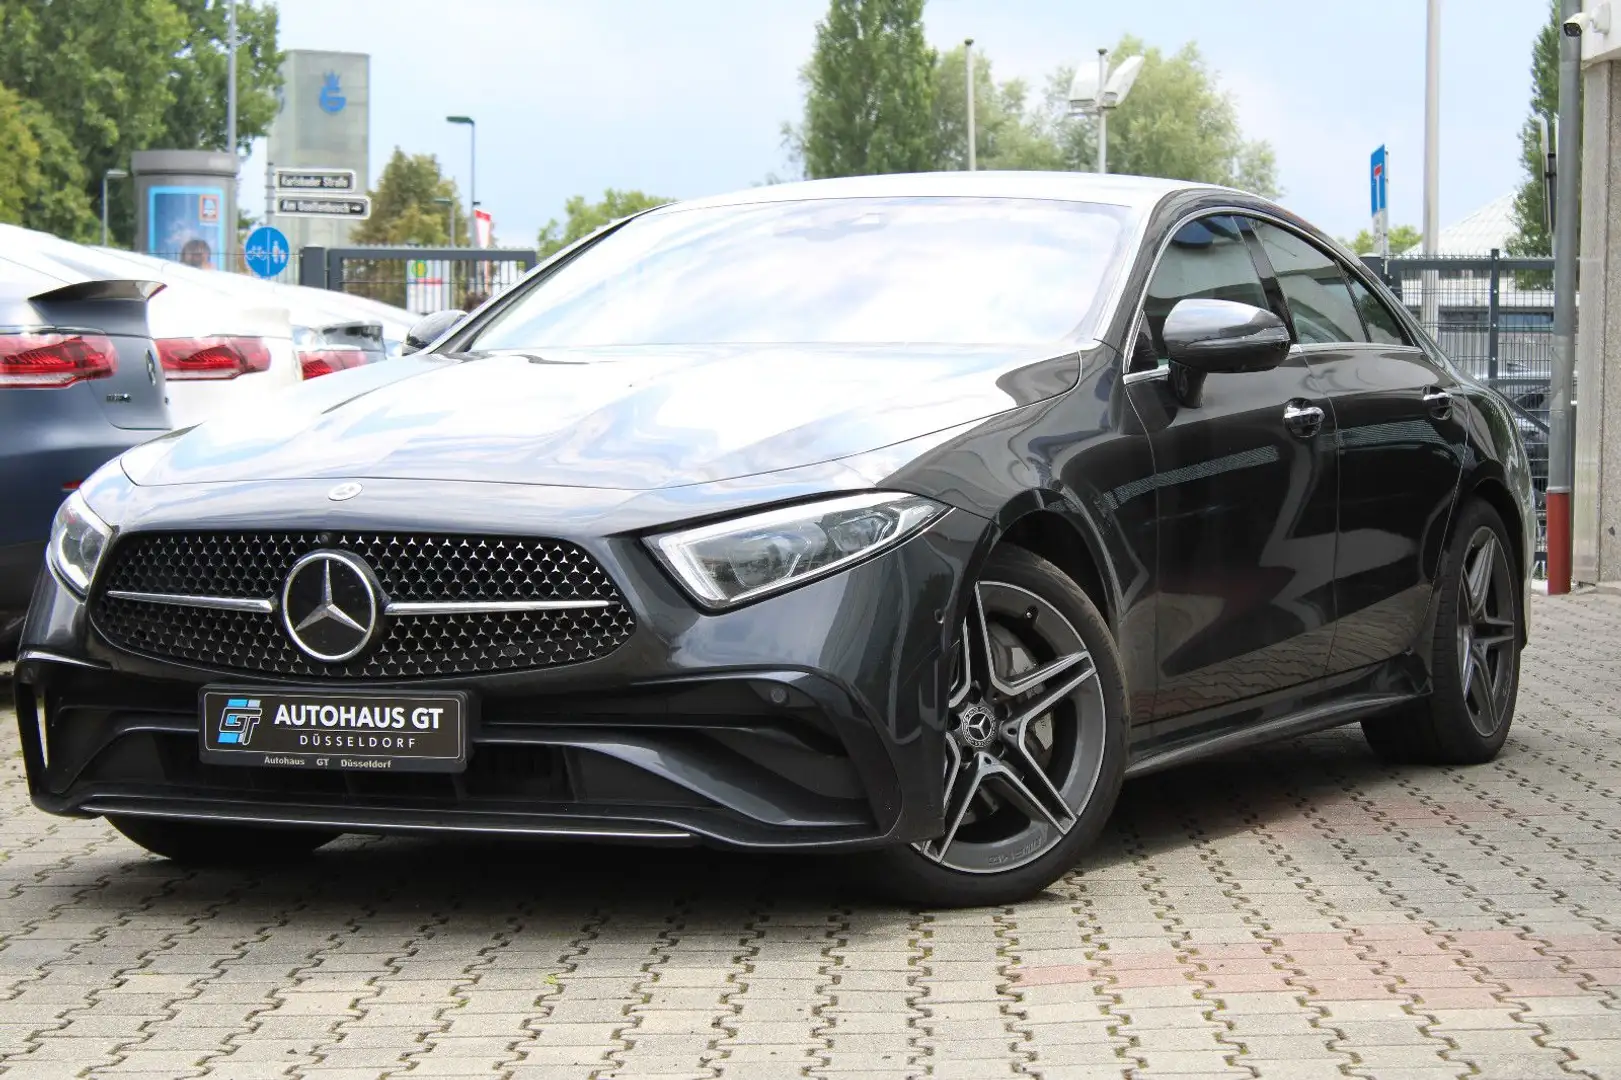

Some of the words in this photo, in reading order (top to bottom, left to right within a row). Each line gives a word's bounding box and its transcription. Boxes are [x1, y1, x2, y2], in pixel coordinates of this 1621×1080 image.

[274, 704, 405, 729] AUTOHAUS
[412, 707, 443, 729] GT
[300, 733, 415, 748] DÜSSELDORF
[264, 756, 305, 766] Autohaus
[316, 758, 330, 766] GT
[341, 759, 391, 768] Düsseldorf
